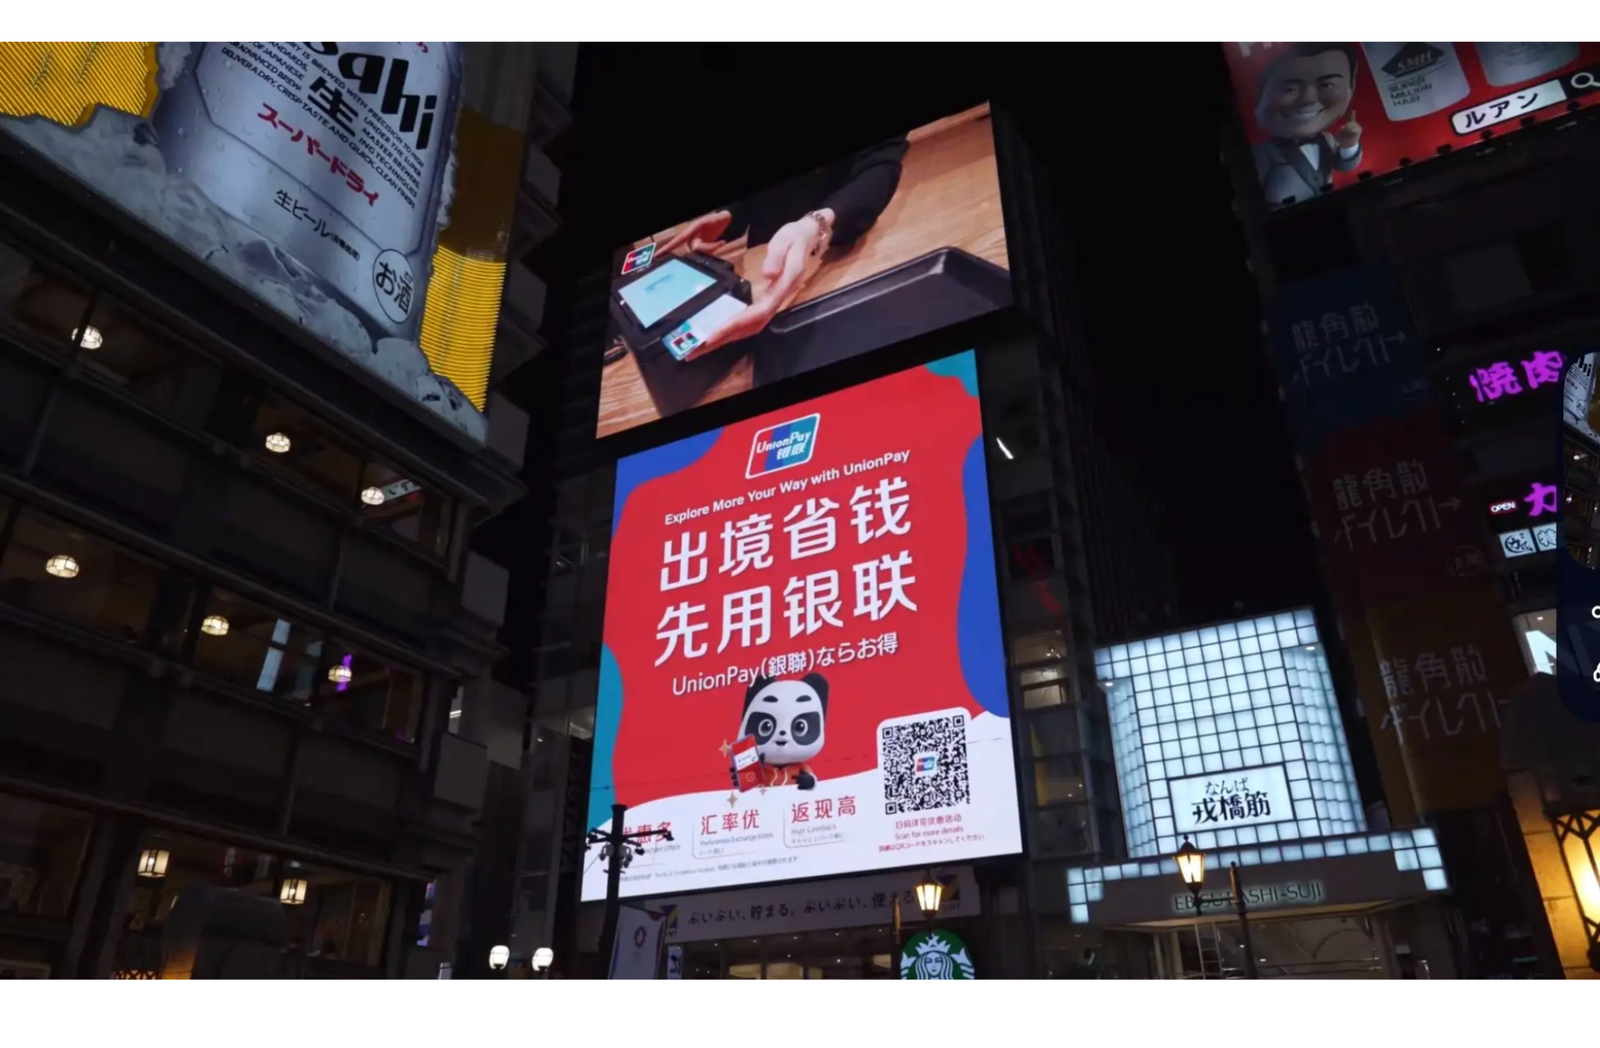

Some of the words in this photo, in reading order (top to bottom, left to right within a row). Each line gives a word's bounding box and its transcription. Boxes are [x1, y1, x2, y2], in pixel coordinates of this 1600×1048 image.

[237, 42, 279, 75] ADVANCED
[358, 136, 376, 155] ING
[374, 151, 419, 198] TECHNIQUES
[261, 46, 305, 81] JAPANESE
[361, 126, 393, 158] MASTER
[301, 50, 311, 59] IS
[310, 57, 346, 89] BREWED
[345, 87, 367, 109] WITH
[367, 106, 403, 144] PRECISION
[402, 142, 412, 153] TO
[307, 76, 359, 138] 生
[1464, 92, 1538, 129] ルアン
[257, 102, 379, 206] スーパードライ
[275, 82, 303, 105] CRISP
[301, 102, 331, 128] TASTE
[327, 124, 349, 144] AND
[374, 165, 398, 189] CLEAN
[362, 116, 391, 143] UNDER
[390, 141, 404, 157] THE
[376, 261, 413, 315] お酒
[756, 430, 812, 455] UnionPay
[664, 504, 709, 526] Explore
[713, 494, 745, 513] More
[747, 486, 776, 503] Your
[779, 477, 808, 496] Way
[811, 464, 840, 486] with
[843, 450, 911, 476] UnionPay
[1490, 501, 1516, 512] OPEN
[660, 476, 912, 592] 出境省钱
[654, 550, 918, 667] 先用银联
[791, 795, 857, 824] 返现高
[1191, 790, 1271, 825] 戎橋筋
[1205, 777, 1250, 795] なんば
[700, 809, 760, 836] 汇率优
[895, 829, 911, 841] Scan
[912, 828, 921, 839] for
[922, 828, 940, 837] more
[941, 825, 963, 835] details
